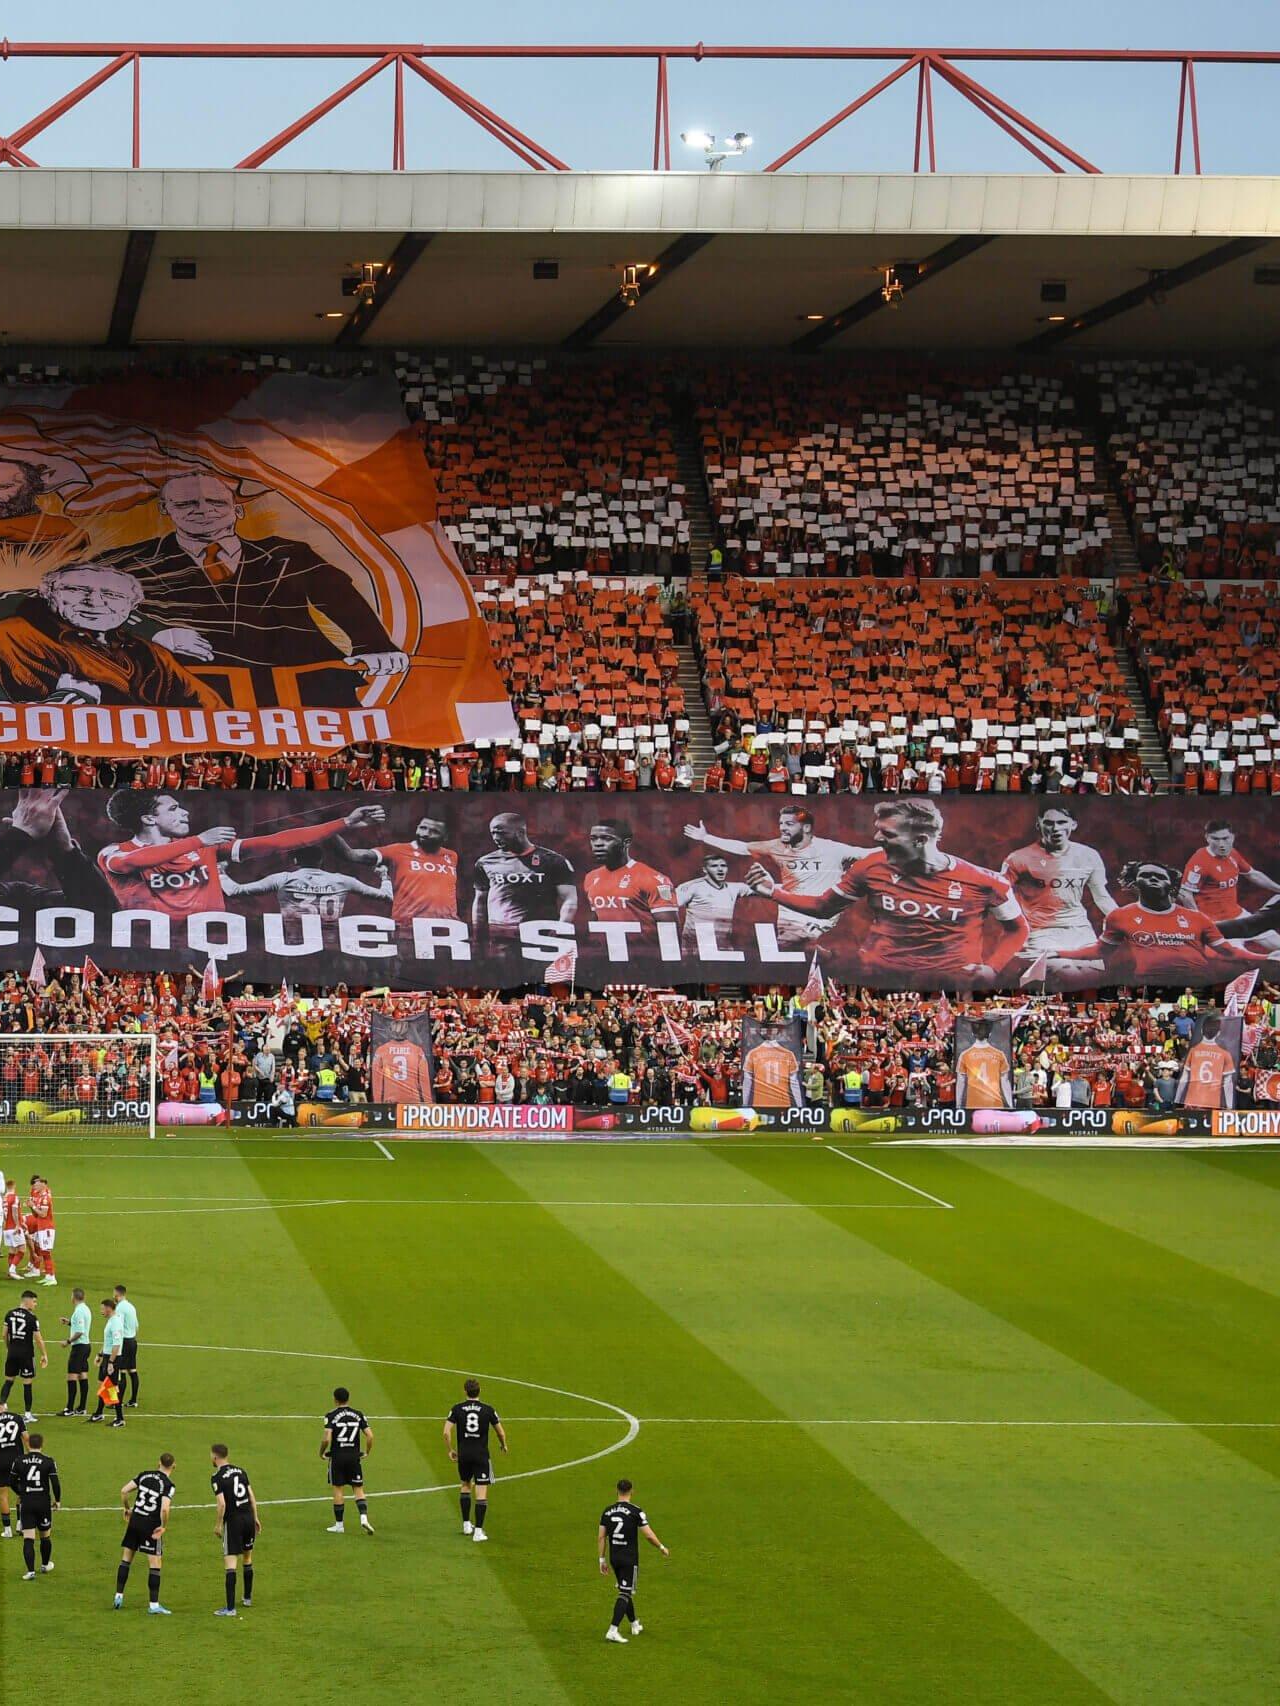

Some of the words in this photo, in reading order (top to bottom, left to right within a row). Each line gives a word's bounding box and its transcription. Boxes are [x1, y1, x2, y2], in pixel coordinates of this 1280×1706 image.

[149, 863, 210, 890] BOXT
[410, 860, 458, 876] BOXT
[781, 860, 823, 872] OXT
[494, 872, 546, 885] BOXT
[1038, 877, 1086, 889] BOXT
[590, 896, 630, 912] OXT
[882, 894, 964, 923] BOXT
[518, 919, 807, 962] STILL
[392, 1055, 408, 1081] 3
[1198, 1060, 1213, 1083] 6
[403, 1105, 566, 1129] iPROHYDRATE.COM
[10, 1316, 26, 1336] 12
[335, 1422, 360, 1442] 27
[466, 1412, 479, 1433] 8
[26, 1465, 40, 1486] 4
[233, 1475, 246, 1498] 6
[135, 1485, 160, 1512] 33
[610, 1516, 625, 1539] 2
